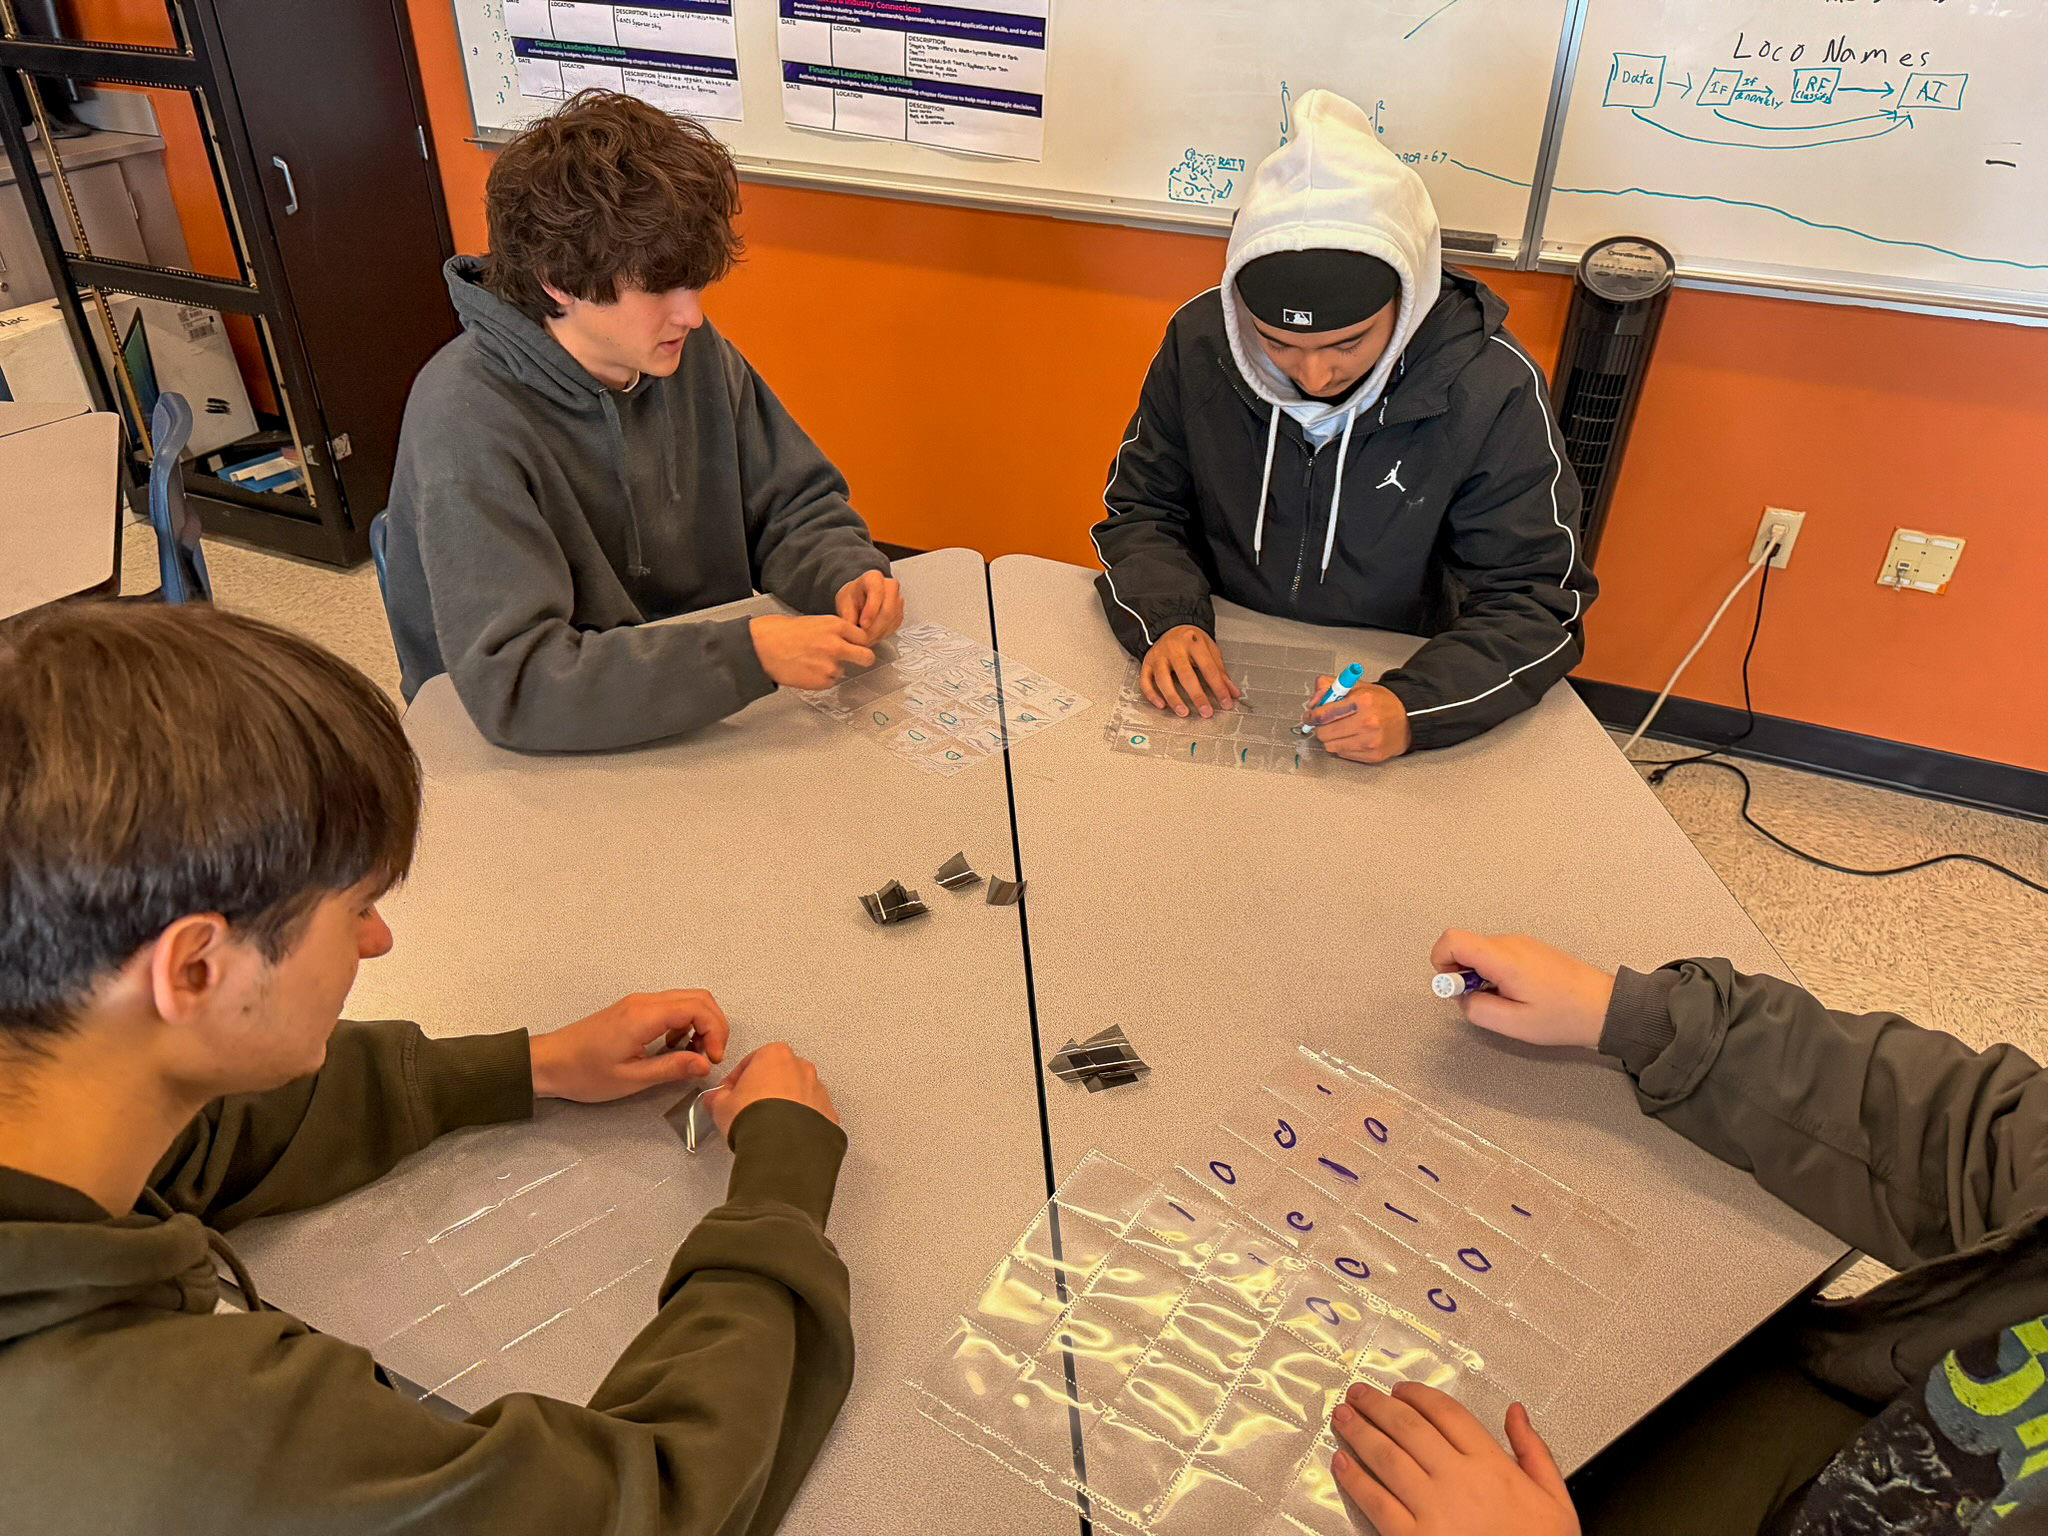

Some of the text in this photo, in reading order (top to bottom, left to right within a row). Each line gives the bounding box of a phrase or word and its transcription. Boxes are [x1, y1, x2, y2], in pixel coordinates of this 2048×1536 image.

[845, 0, 875, 9] Industry
[876, 1, 922, 13] Connections
[794, 2, 820, 10] Partnership
[853, 9, 876, 18] including
[961, 21, 989, 30] application
[1027, 30, 1043, 38] direct
[833, 25, 861, 33] LOCATION
[908, 35, 946, 45] DESCRIPTION
[535, 40, 627, 55] Financial Leadership Activities
[1733, 32, 1930, 67] Loco Names
[624, 70, 656, 79] DESCRIPTION
[808, 65, 913, 86] Financial Leadership Activities
[1622, 70, 1655, 85] Data
[1709, 81, 1729, 95] IF
[1805, 75, 1832, 92] RF
[798, 73, 817, 81] Actively
[817, 76, 840, 84] managing
[898, 87, 919, 96] handling
[919, 90, 936, 98] chapter
[937, 92, 958, 101] finances
[965, 96, 976, 104] help
[991, 100, 1012, 109] strategic
[1013, 103, 1037, 112] decisions.
[836, 90, 863, 99] LOCATION
[1916, 80, 1949, 103] AI
[909, 102, 945, 112] DESCRIPTION
[1378, 100, 1385, 110] 2
[1432, 150, 1447, 164] 67
